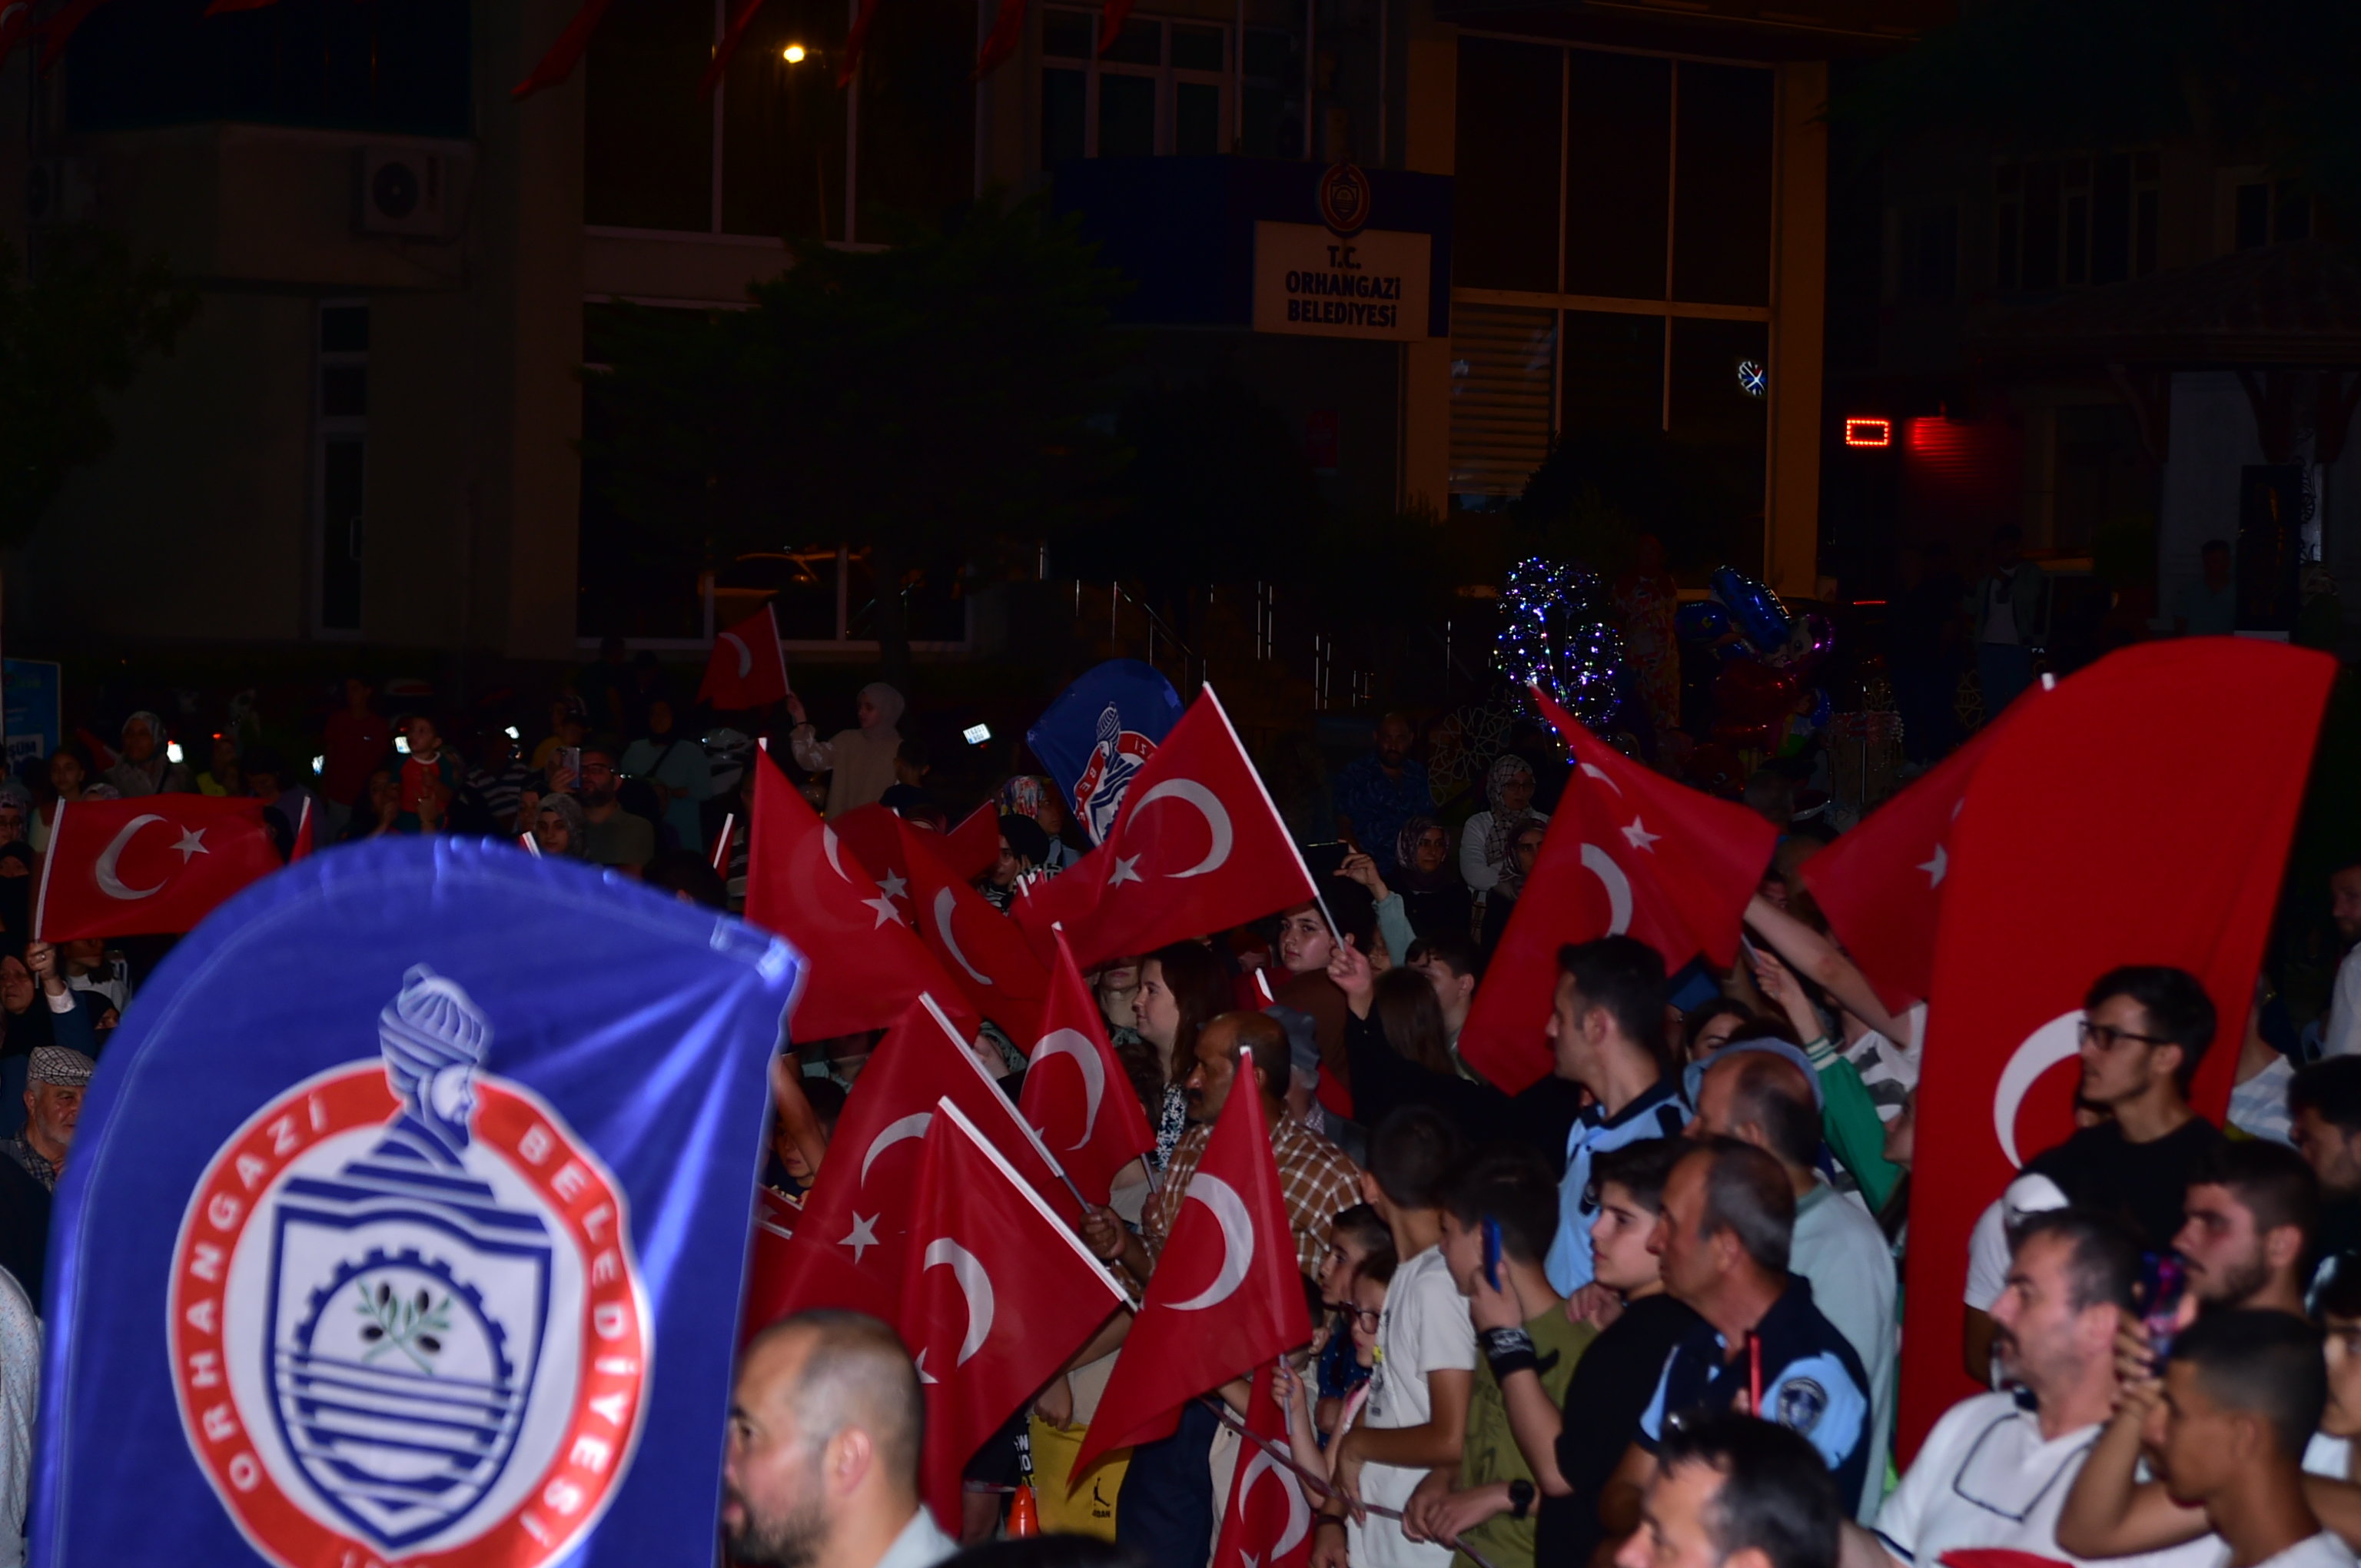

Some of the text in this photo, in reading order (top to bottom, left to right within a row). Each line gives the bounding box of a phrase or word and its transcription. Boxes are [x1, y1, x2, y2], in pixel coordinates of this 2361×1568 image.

[1327, 244, 1362, 269] T.C.
[1285, 270, 1401, 301] ORHANGAZİ
[1287, 299, 1397, 328] BELEDİYESİ
[186, 1093, 328, 1493] ORHANGAZİ
[516, 1122, 639, 1547] BELEDİYESİ
